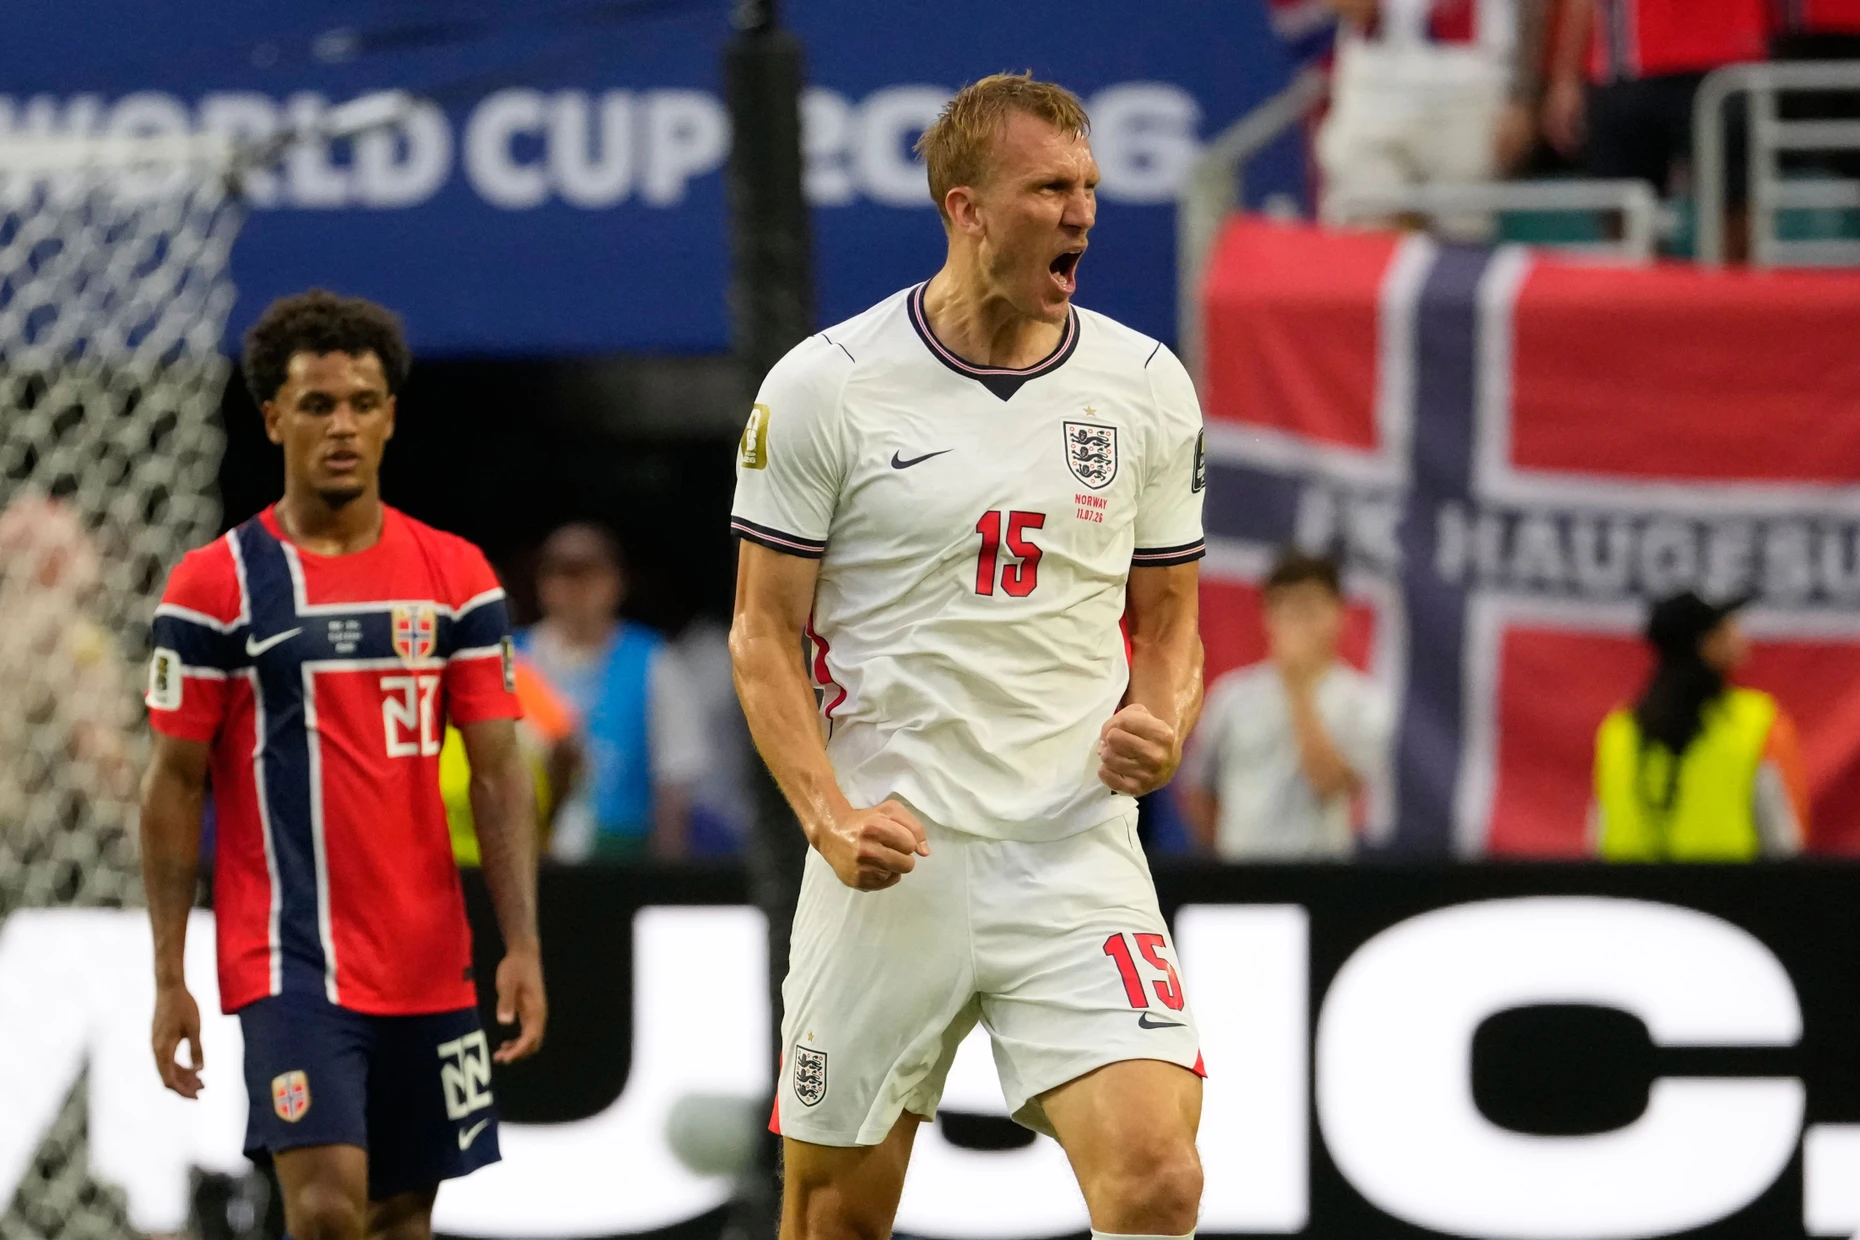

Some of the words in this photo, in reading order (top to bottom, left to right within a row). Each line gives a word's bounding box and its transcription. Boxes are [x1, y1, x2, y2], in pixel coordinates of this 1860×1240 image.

[463, 87, 735, 210] CUP
[802, 82, 1200, 206] 206
[1075, 493, 1107, 510] NORWAY
[1076, 507, 1103, 523] 11.07.26
[975, 510, 1046, 598] 15
[1102, 932, 1185, 1011] 15
[437, 1028, 494, 1120] 22
